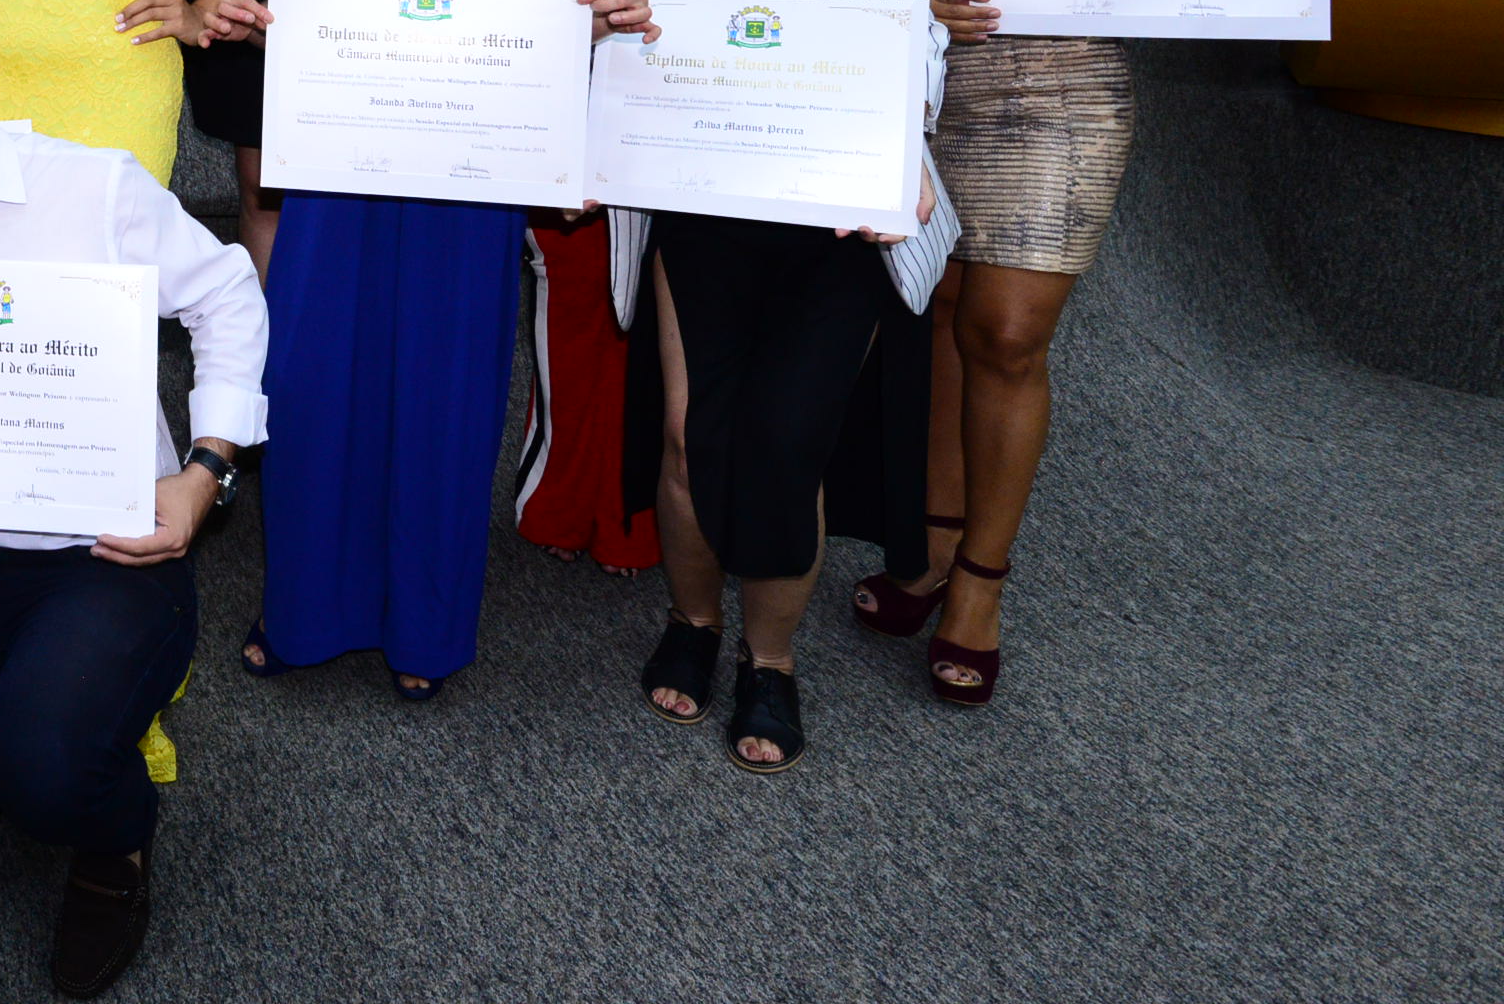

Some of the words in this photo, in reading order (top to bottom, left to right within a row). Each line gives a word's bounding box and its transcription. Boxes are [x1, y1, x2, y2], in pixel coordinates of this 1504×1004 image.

[318, 25, 378, 43] Diploma
[383, 29, 399, 43] de
[482, 33, 534, 50] Mérito
[337, 47, 381, 61] Câmara
[645, 52, 705, 69] Diploma
[663, 72, 708, 86] Câmara
[723, 121, 763, 133] Martins
[766, 124, 804, 136] Pereira
[19, 341, 38, 355] ao
[44, 339, 99, 358] Mérito
[9, 361, 23, 375] de
[26, 362, 76, 378] Goiânia
[23, 417, 65, 431] Martins
